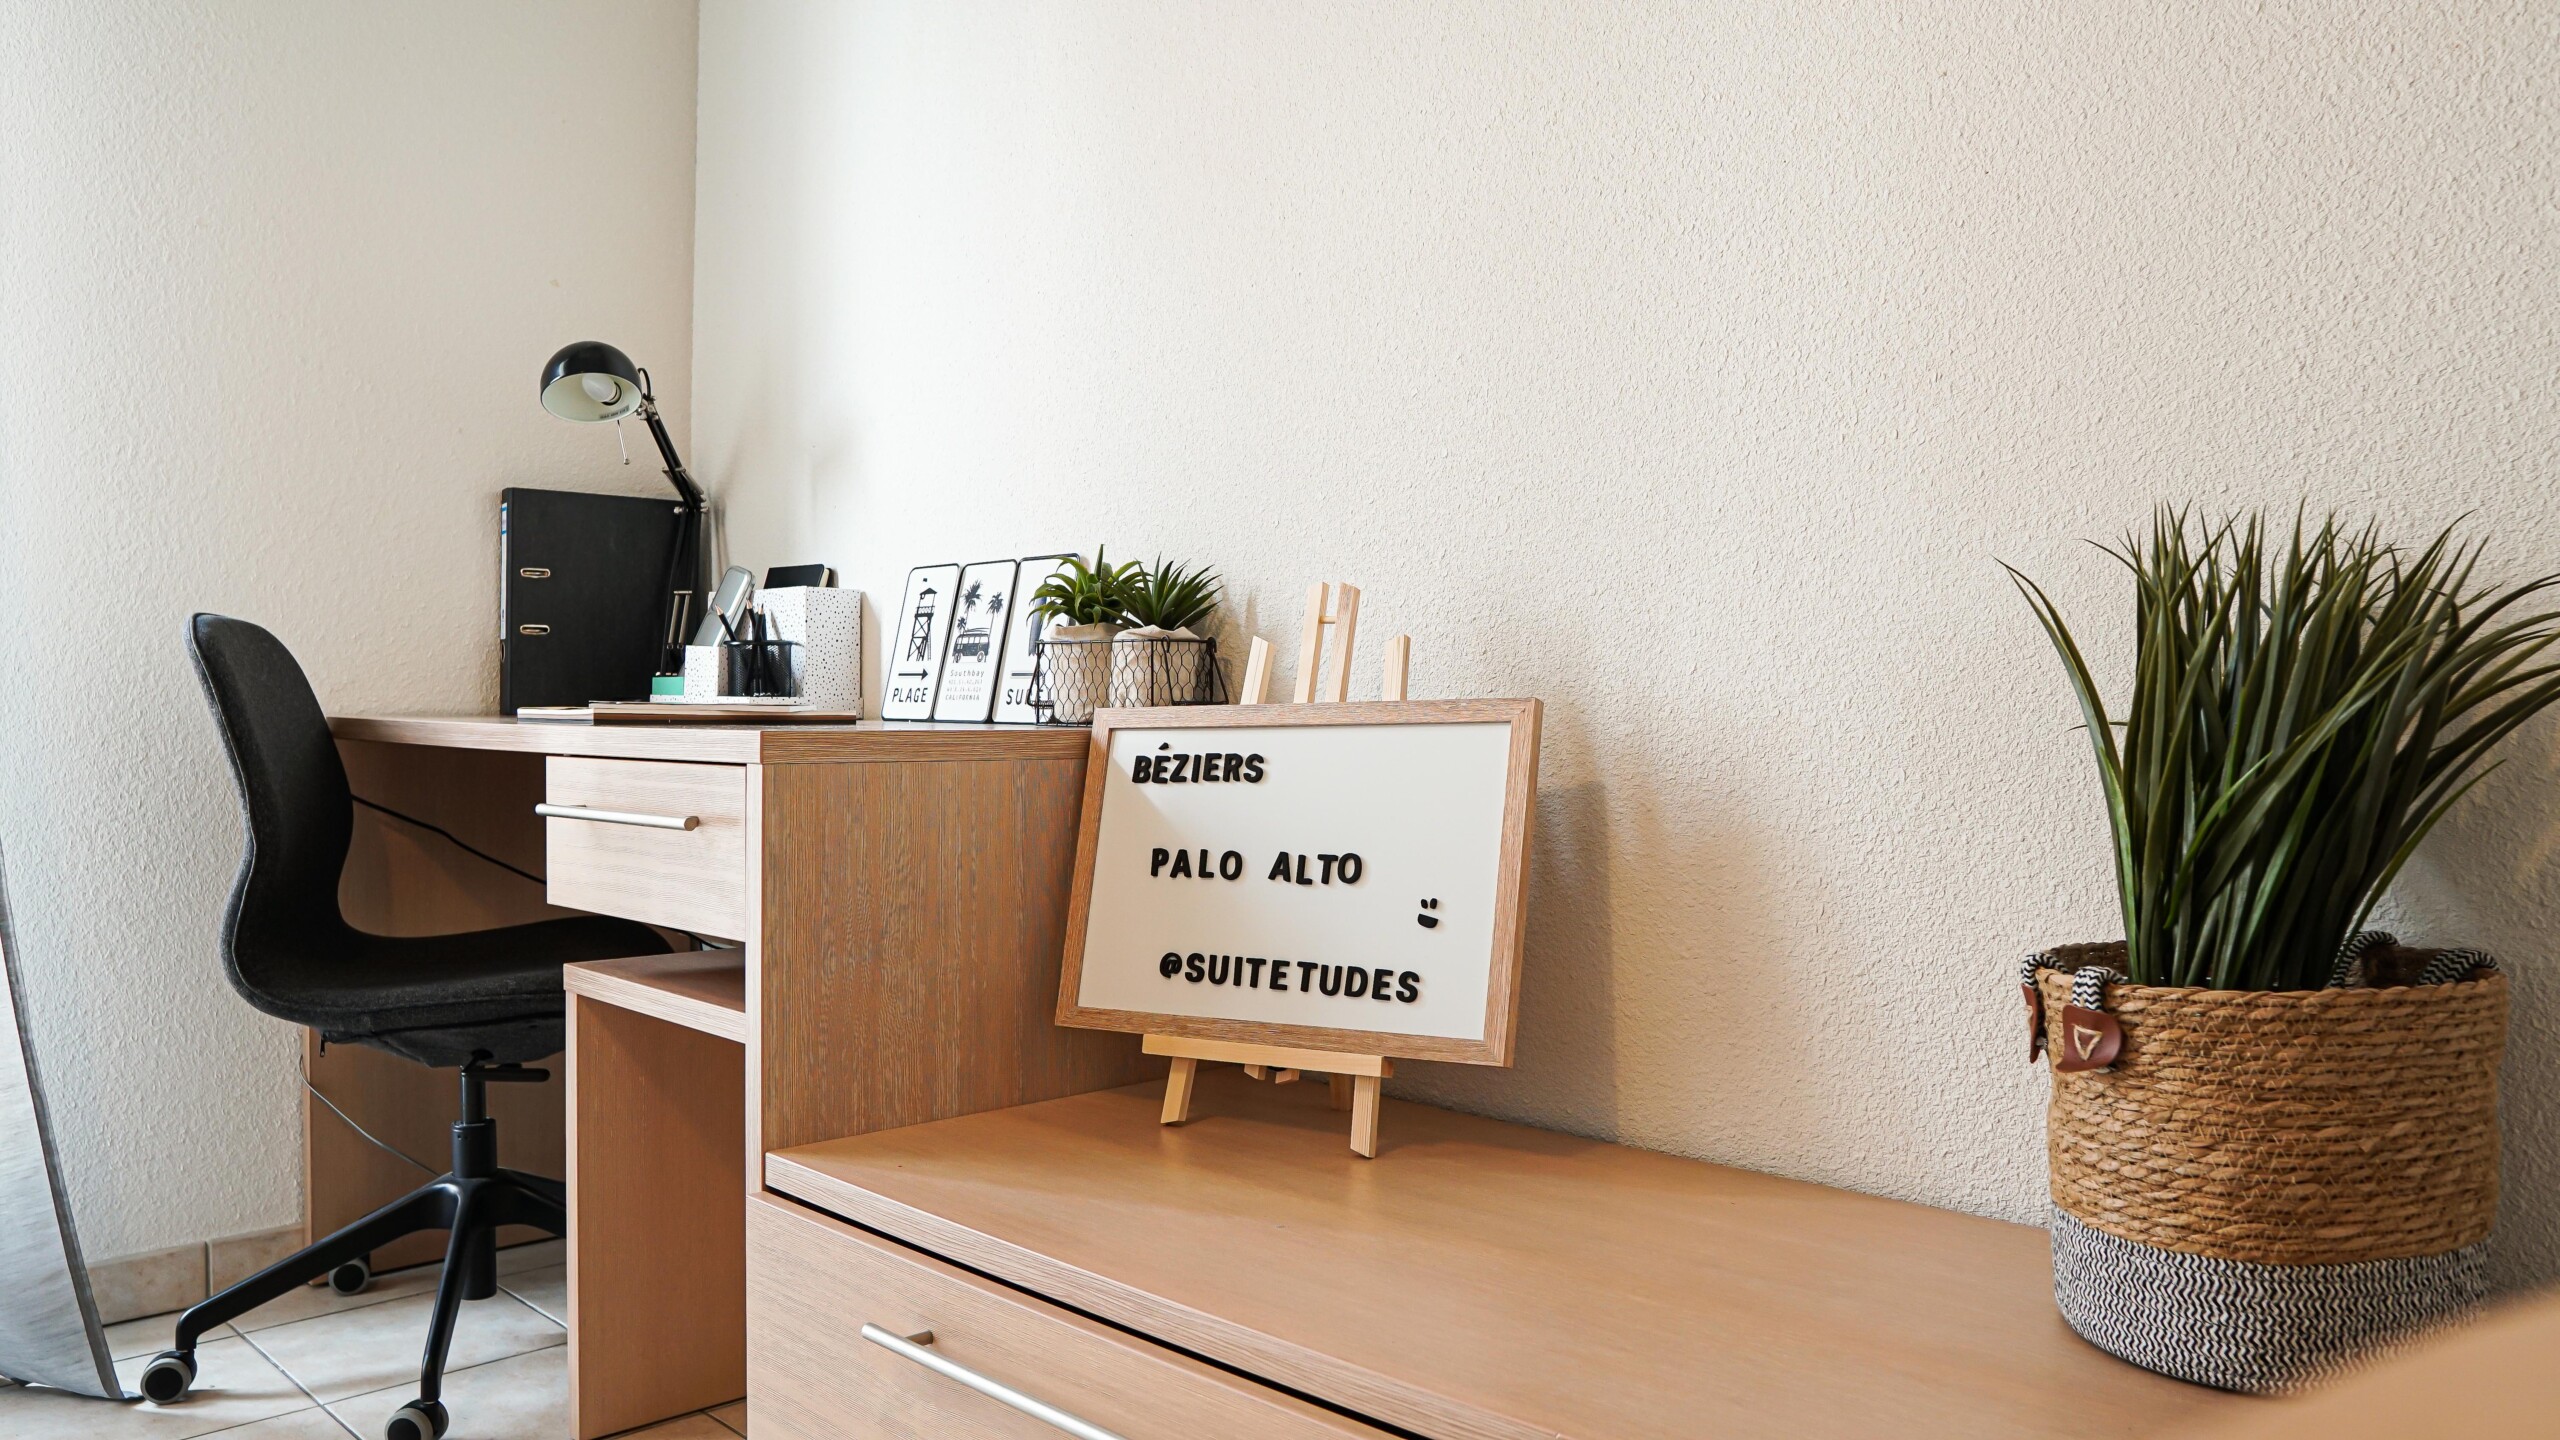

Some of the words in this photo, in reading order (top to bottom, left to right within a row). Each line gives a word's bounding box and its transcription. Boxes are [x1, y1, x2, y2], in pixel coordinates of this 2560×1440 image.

[891, 687, 928, 703] PLAGE
[1005, 688, 1044, 706] SU
[1132, 742, 1265, 785] BÉZIERS
[1150, 847, 1243, 881] PALO
[1268, 851, 1363, 886] ALTO
[1159, 951, 1421, 1004] @SUITETUDES
